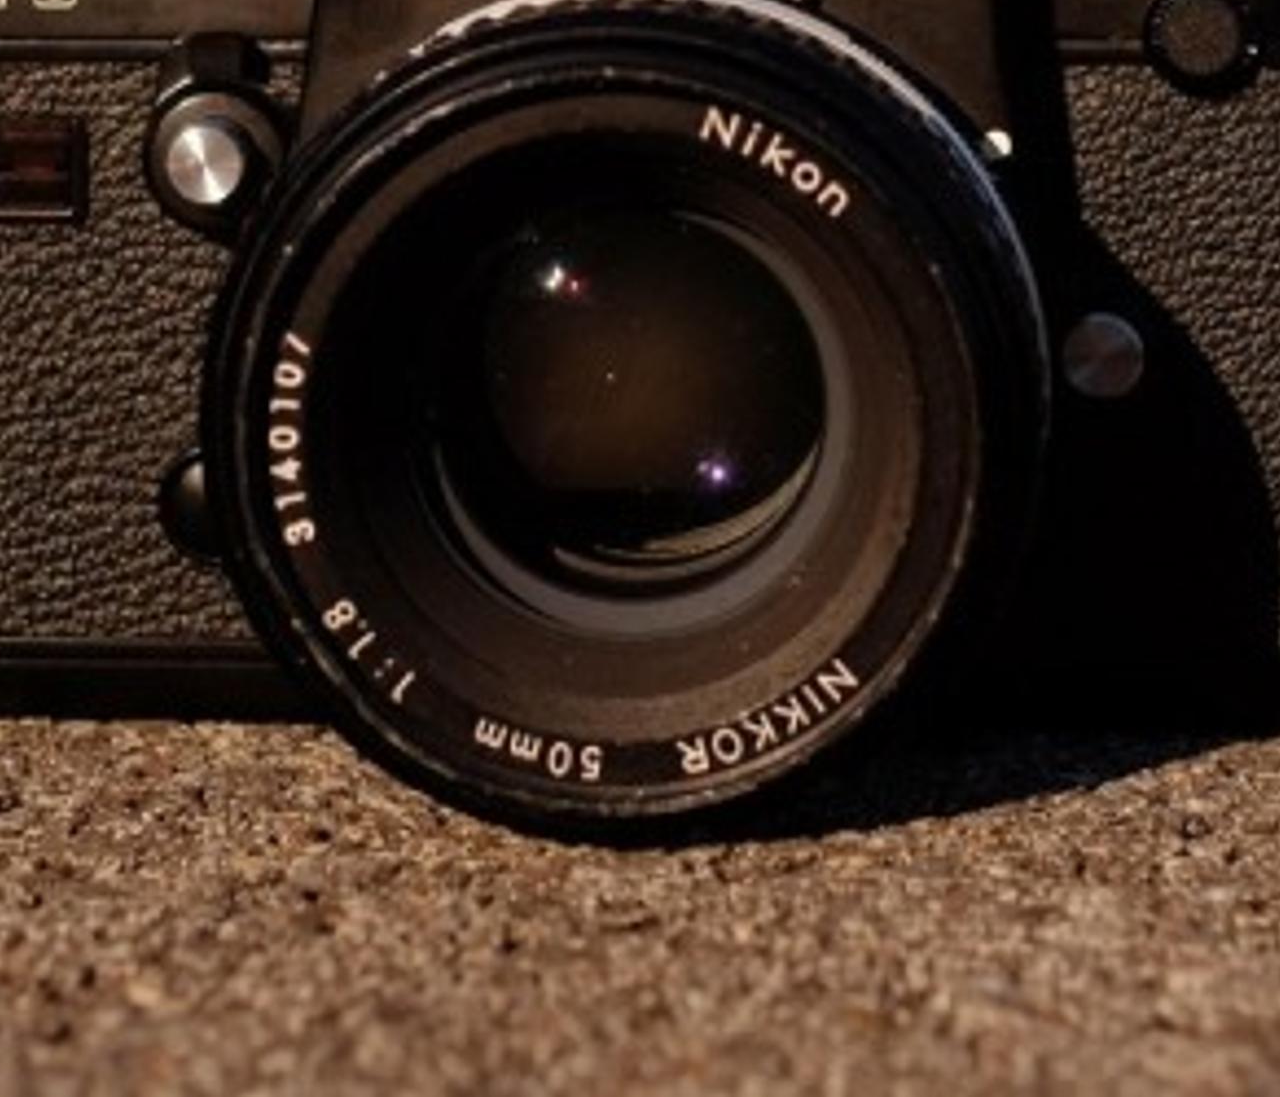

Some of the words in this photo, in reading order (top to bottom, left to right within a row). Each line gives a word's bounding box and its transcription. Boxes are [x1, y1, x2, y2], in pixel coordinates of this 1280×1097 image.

[699, 107, 849, 217] Nikon
[474, 718, 602, 782] 50mm
[676, 658, 858, 775] NIKKOR
